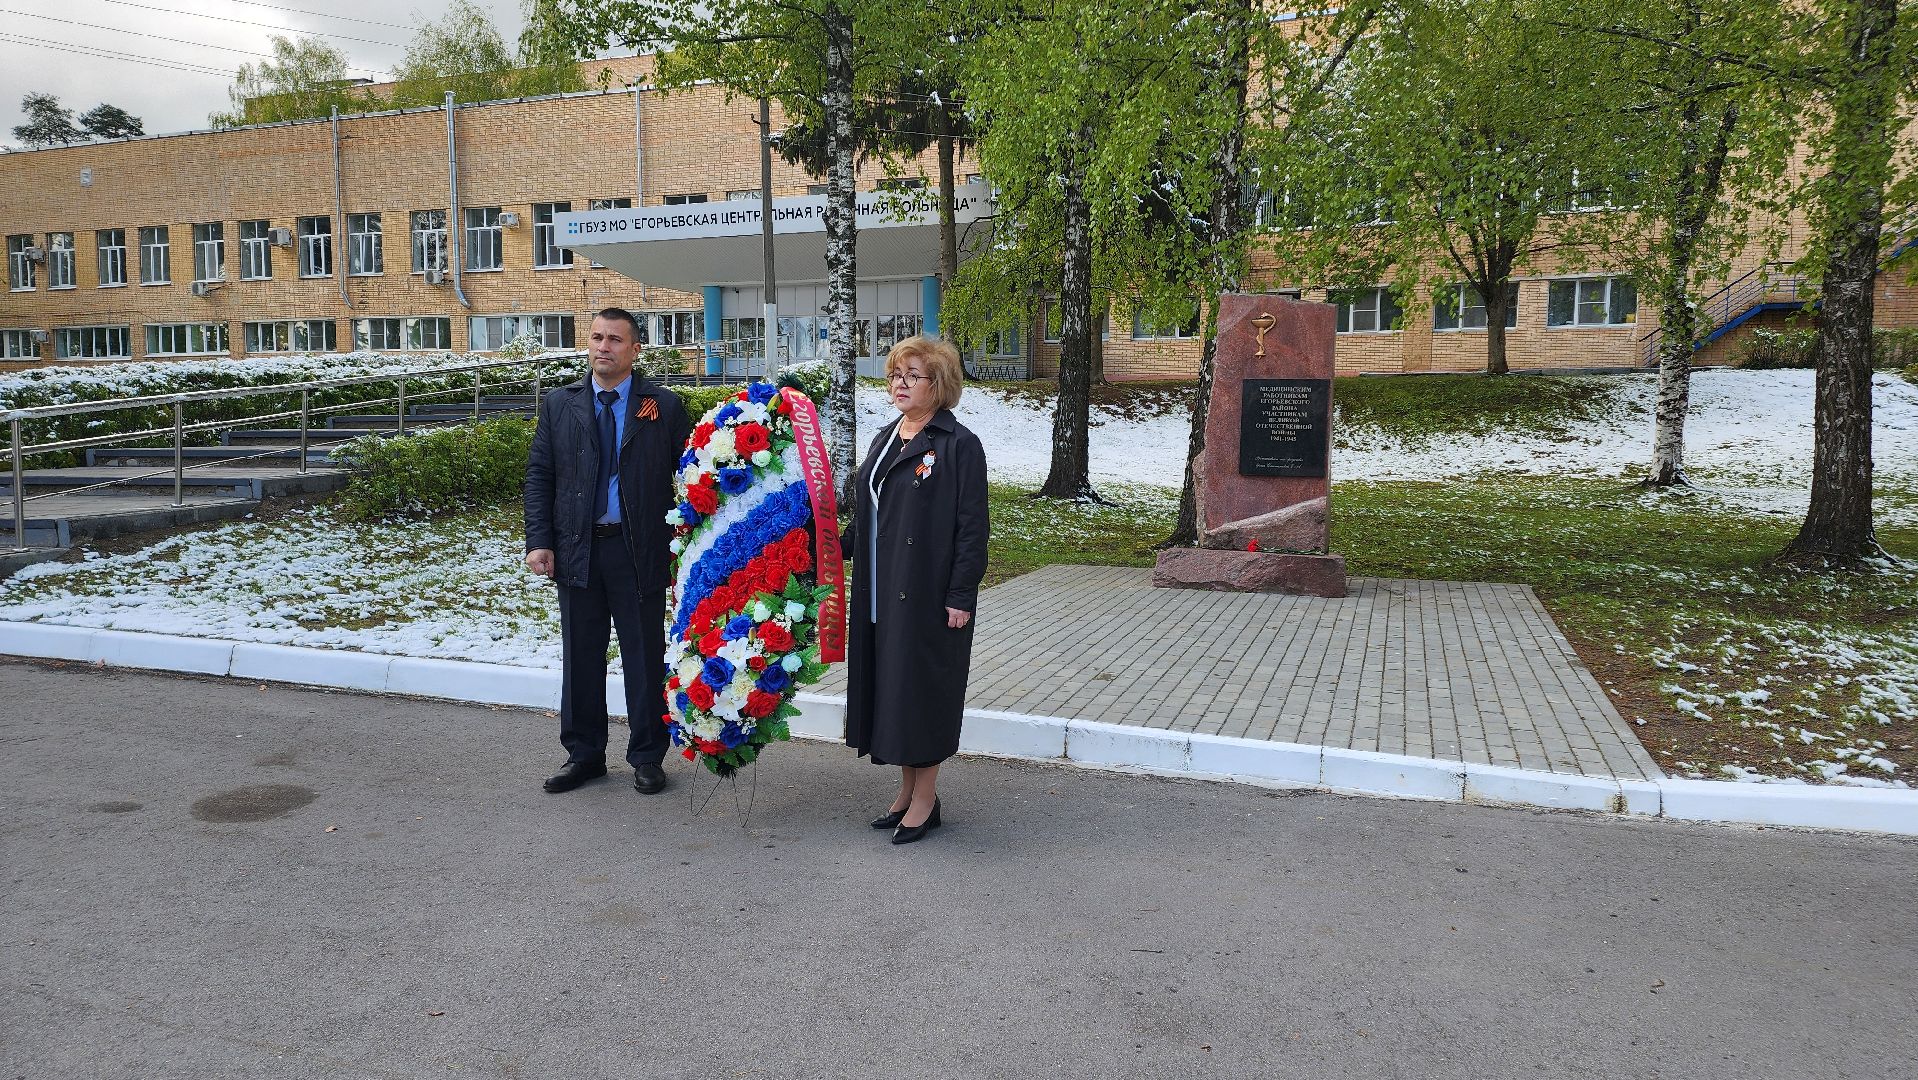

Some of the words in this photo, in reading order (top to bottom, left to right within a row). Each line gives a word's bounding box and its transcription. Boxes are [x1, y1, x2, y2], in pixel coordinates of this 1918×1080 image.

[579, 220, 607, 234] ГБУЗ
[609, 219, 628, 232] МО
[629, 213, 718, 230] "ЕГОРЬЕВСКАЯ
[721, 206, 812, 226] ЦЕНТРЛЬНАЯ
[816, 202, 889, 218] РННАЯ
[893, 197, 977, 213] БОЛЬНЦА"
